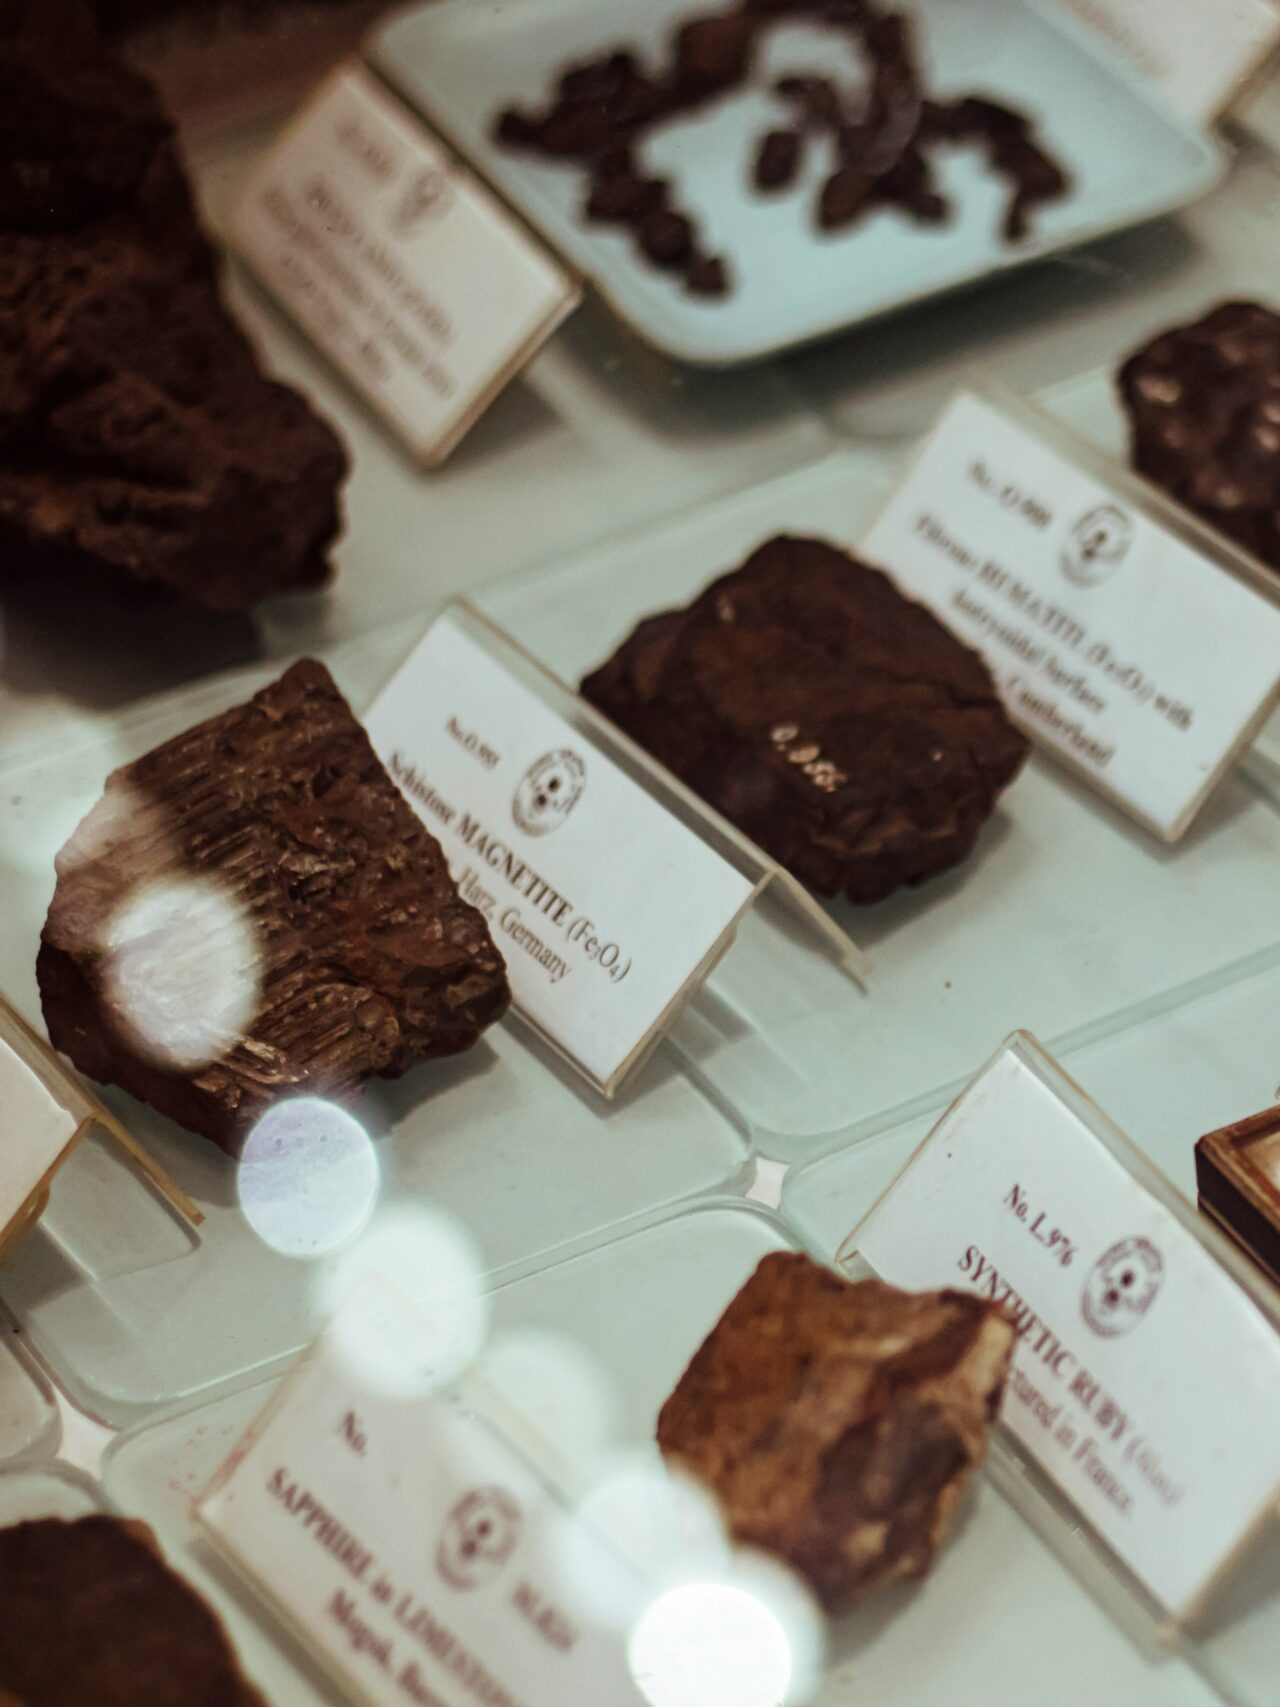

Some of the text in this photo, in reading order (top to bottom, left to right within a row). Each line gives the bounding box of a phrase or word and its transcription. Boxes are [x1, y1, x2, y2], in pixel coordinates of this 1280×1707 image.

[1154, 695, 1192, 731] with
[458, 814, 572, 926] MAGNETITE
[499, 907, 573, 984] Germany
[1069, 1370, 1129, 1443] RUBY
